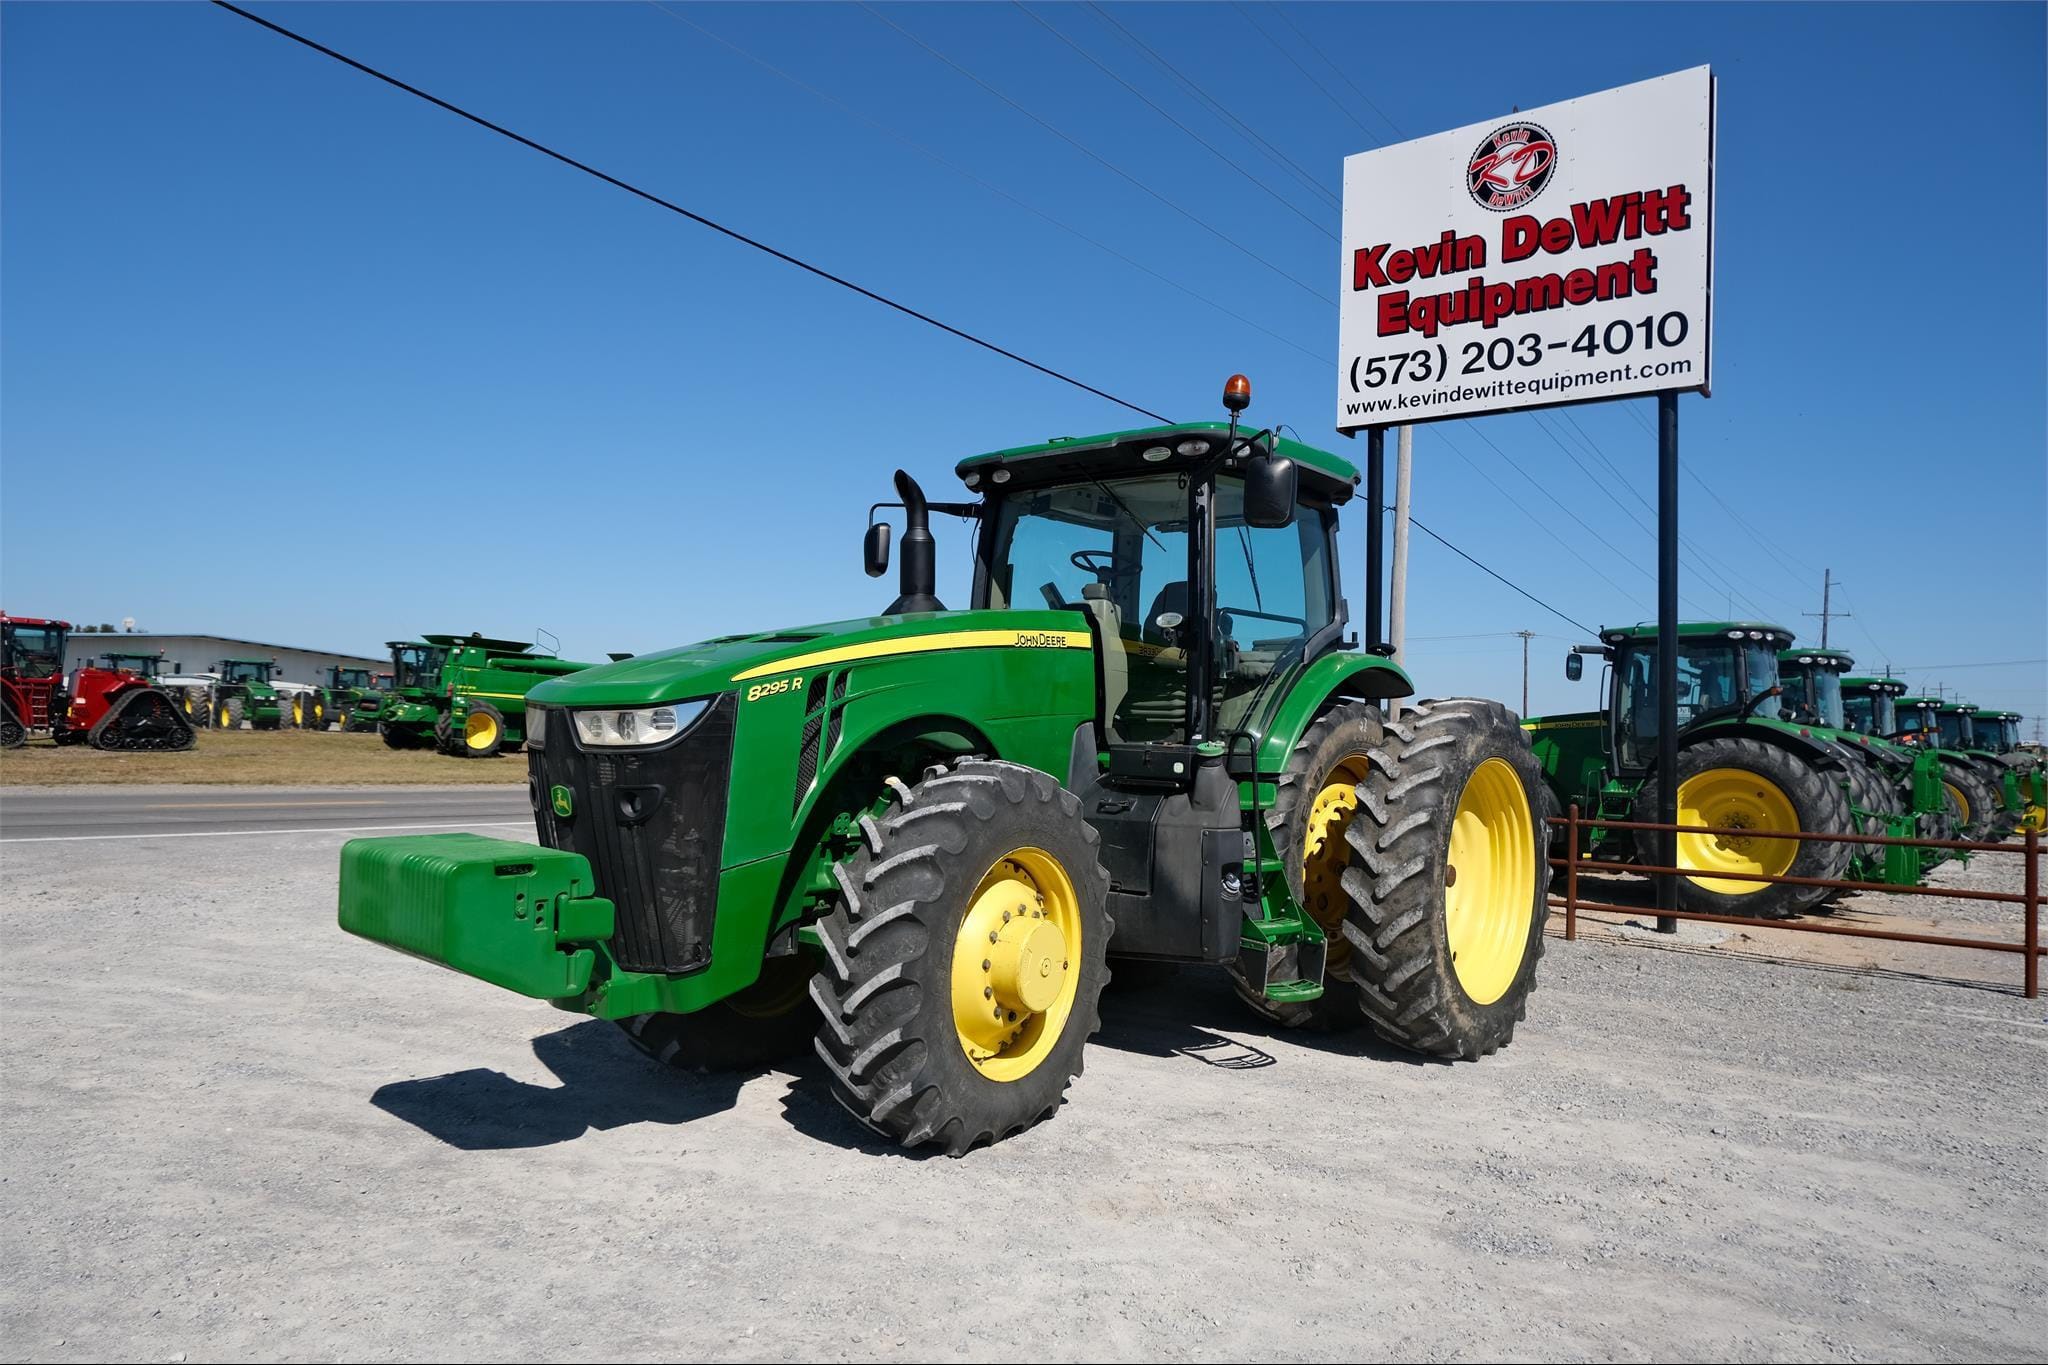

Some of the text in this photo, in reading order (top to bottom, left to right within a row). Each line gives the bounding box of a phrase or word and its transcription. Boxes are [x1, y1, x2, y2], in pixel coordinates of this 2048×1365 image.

[1493, 127, 1531, 149] Kevin
[1469, 140, 1555, 193] KD
[1488, 184, 1534, 207] DeWitt
[1354, 184, 1691, 291] Kevin DeWitt
[1377, 248, 1657, 338] Equipment
[1350, 311, 1689, 392] (573) 203-4010
[1346, 360, 1692, 415] www.kevindewittequipment.com
[747, 677, 803, 702] 8295 R
